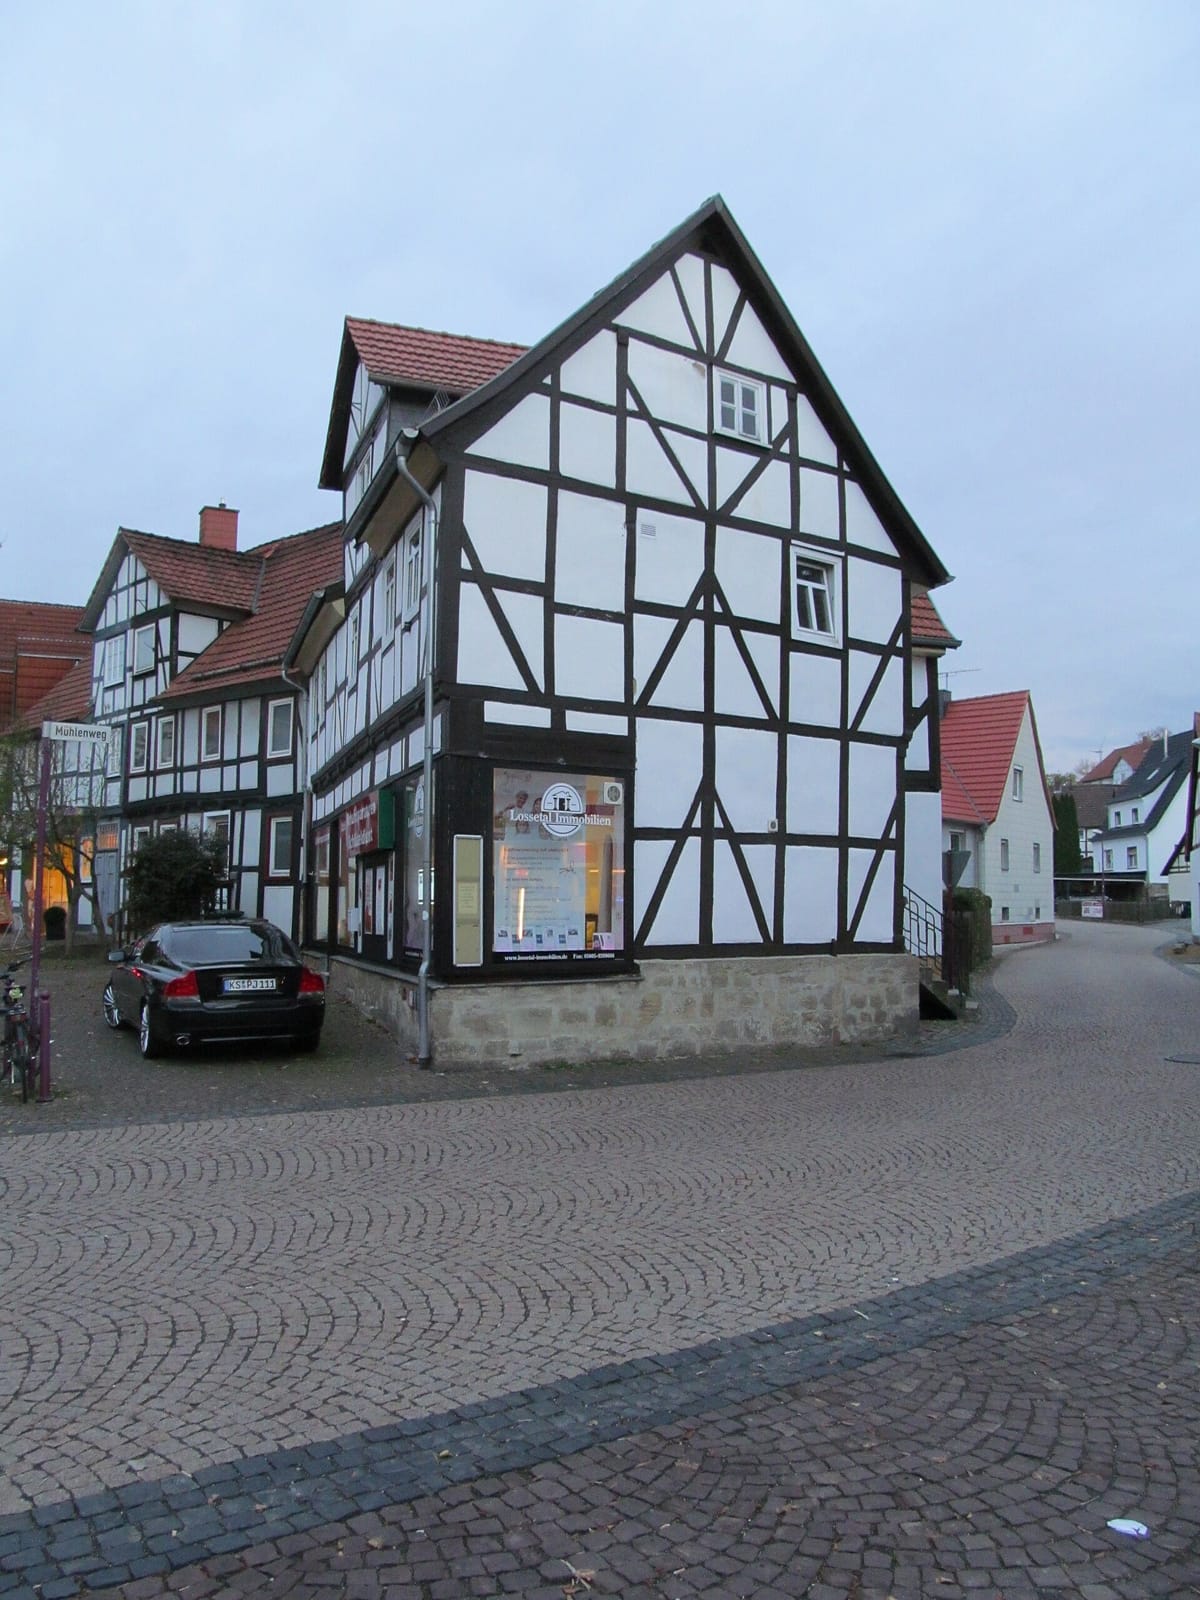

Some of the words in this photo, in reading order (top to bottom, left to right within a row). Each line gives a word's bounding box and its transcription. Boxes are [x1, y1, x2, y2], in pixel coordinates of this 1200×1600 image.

[55, 724, 107, 742] Mühlenweg
[509, 809, 552, 821] Lossetal
[555, 812, 612, 826] Immobilien
[229, 980, 241, 989] KS
